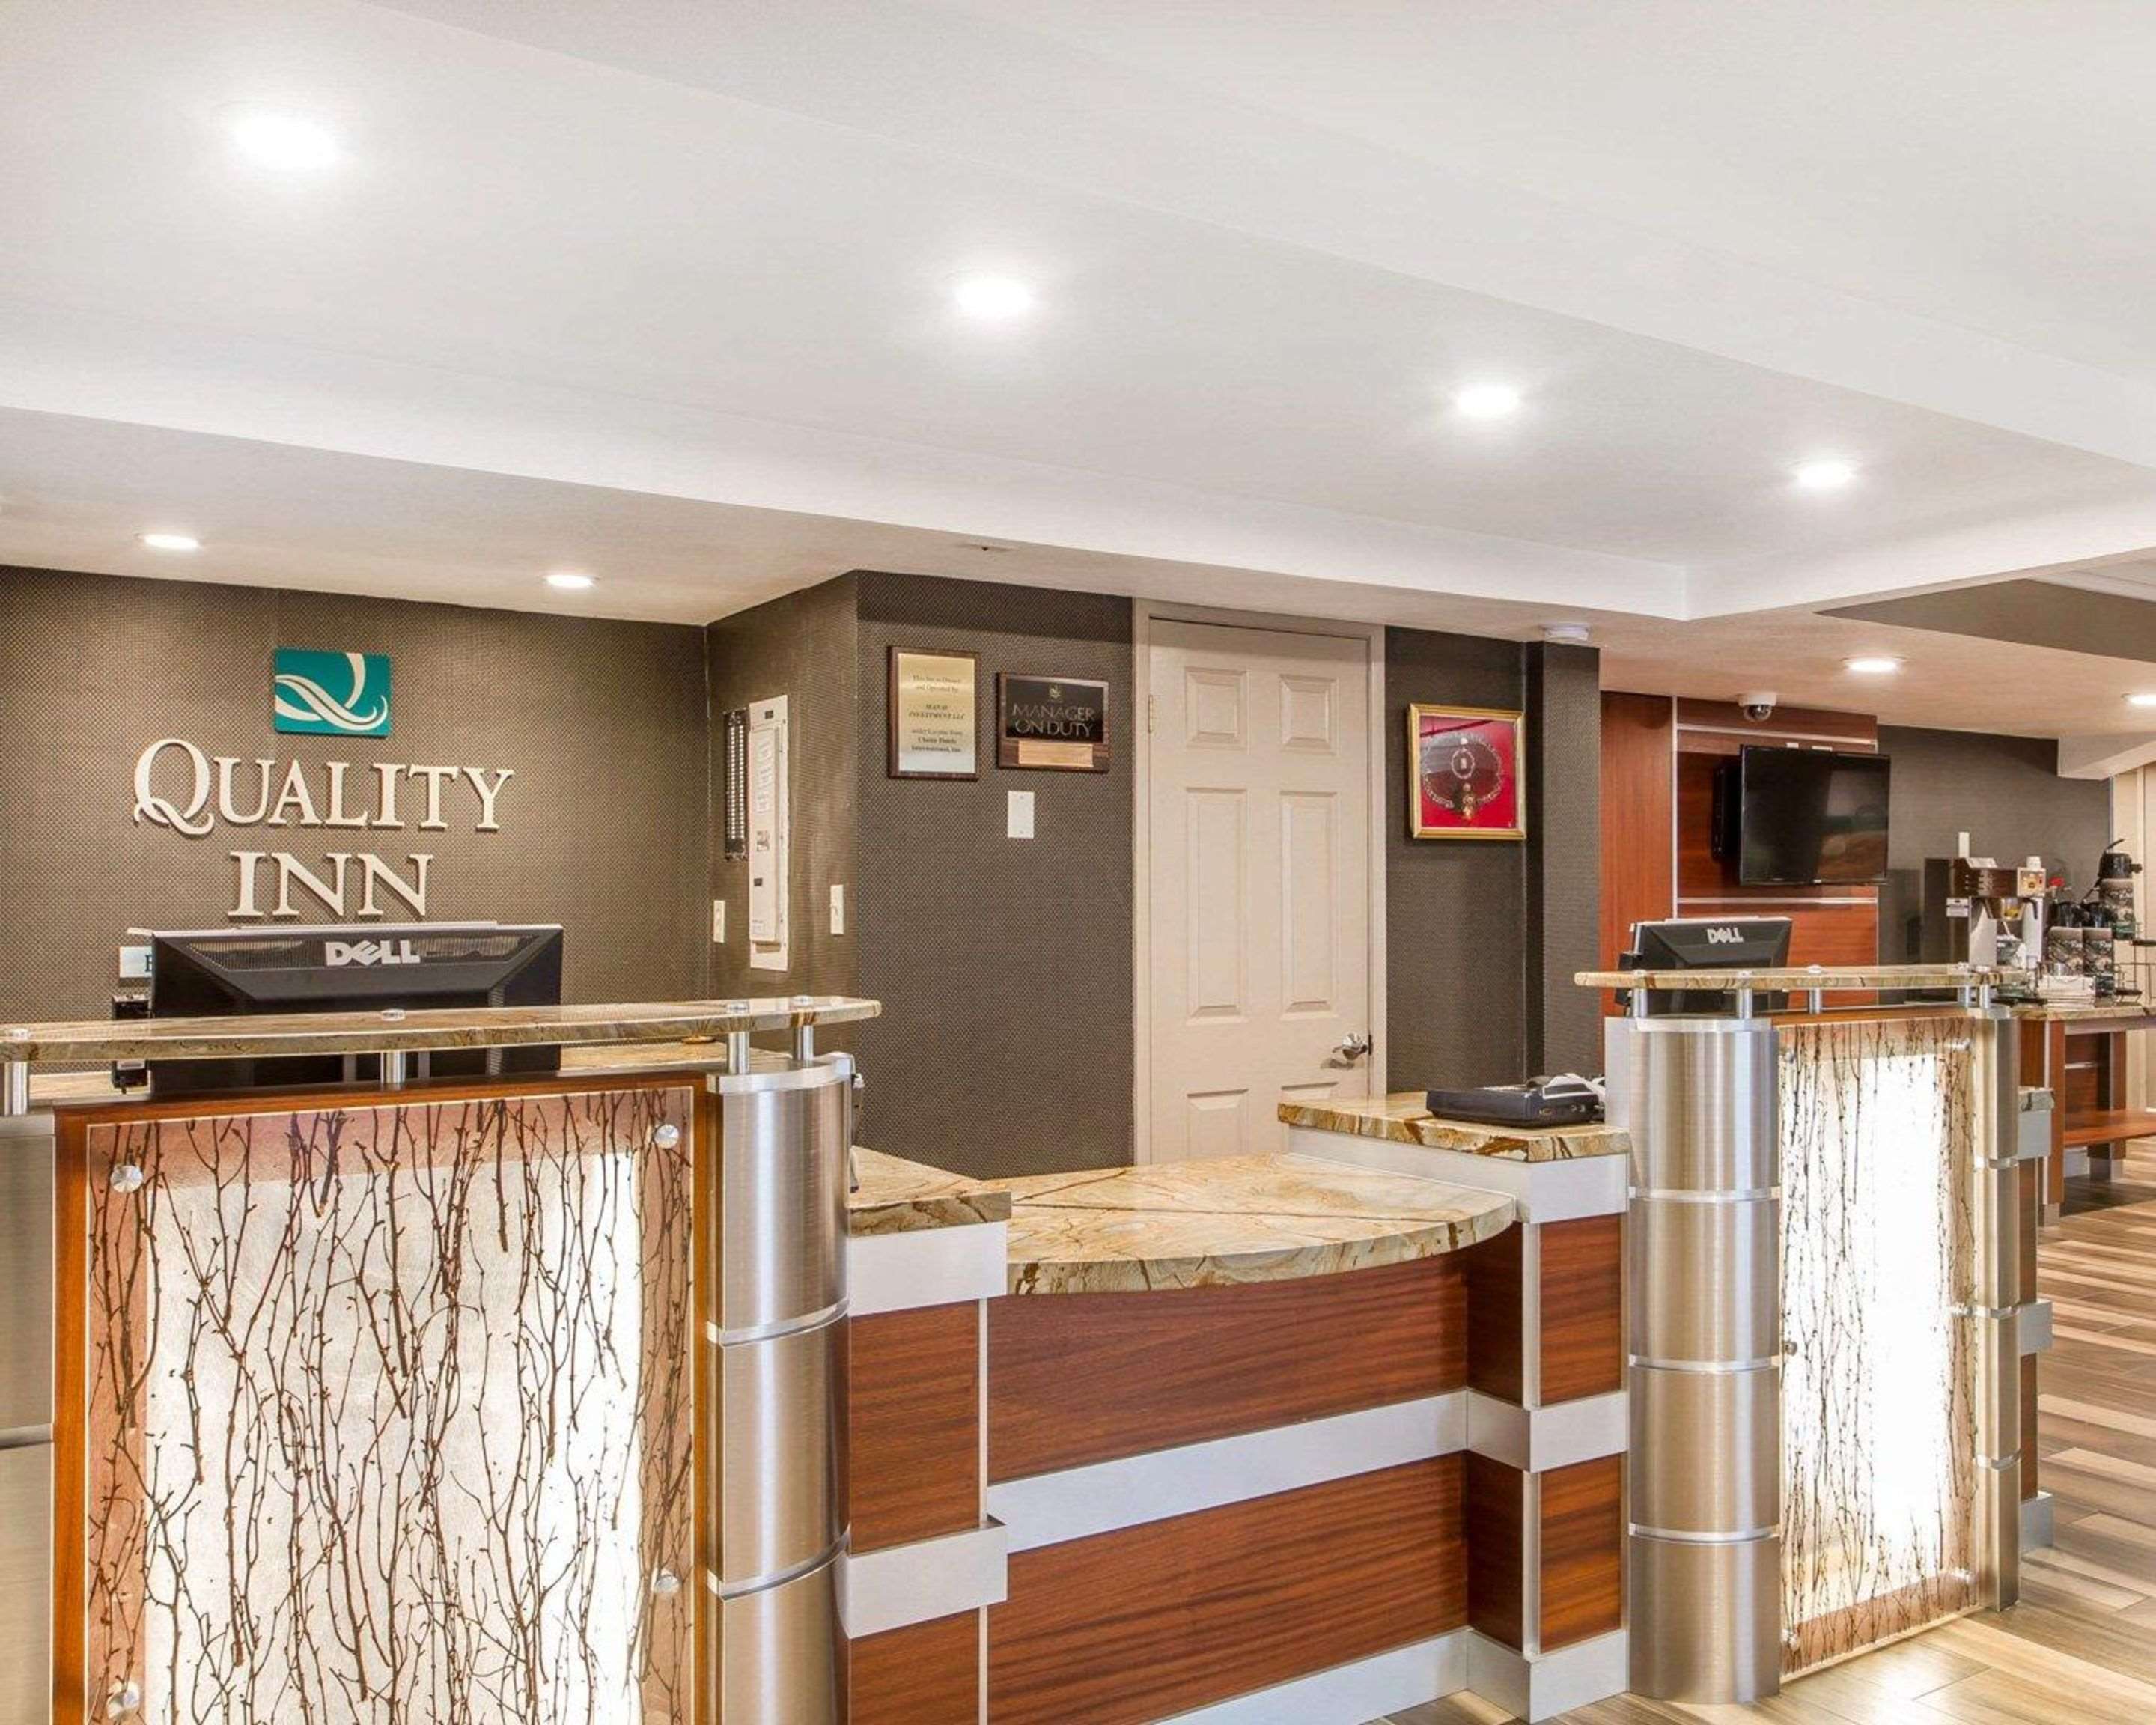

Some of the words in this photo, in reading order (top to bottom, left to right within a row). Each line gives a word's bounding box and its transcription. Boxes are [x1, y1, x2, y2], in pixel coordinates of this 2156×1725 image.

[1012, 703, 1095, 721] MANAGER
[1015, 719, 1044, 734] ON
[1047, 721, 1094, 737] DUTY
[227, 851, 434, 918] INN
[1706, 928, 1744, 944] DELL
[325, 940, 421, 966] DELL
